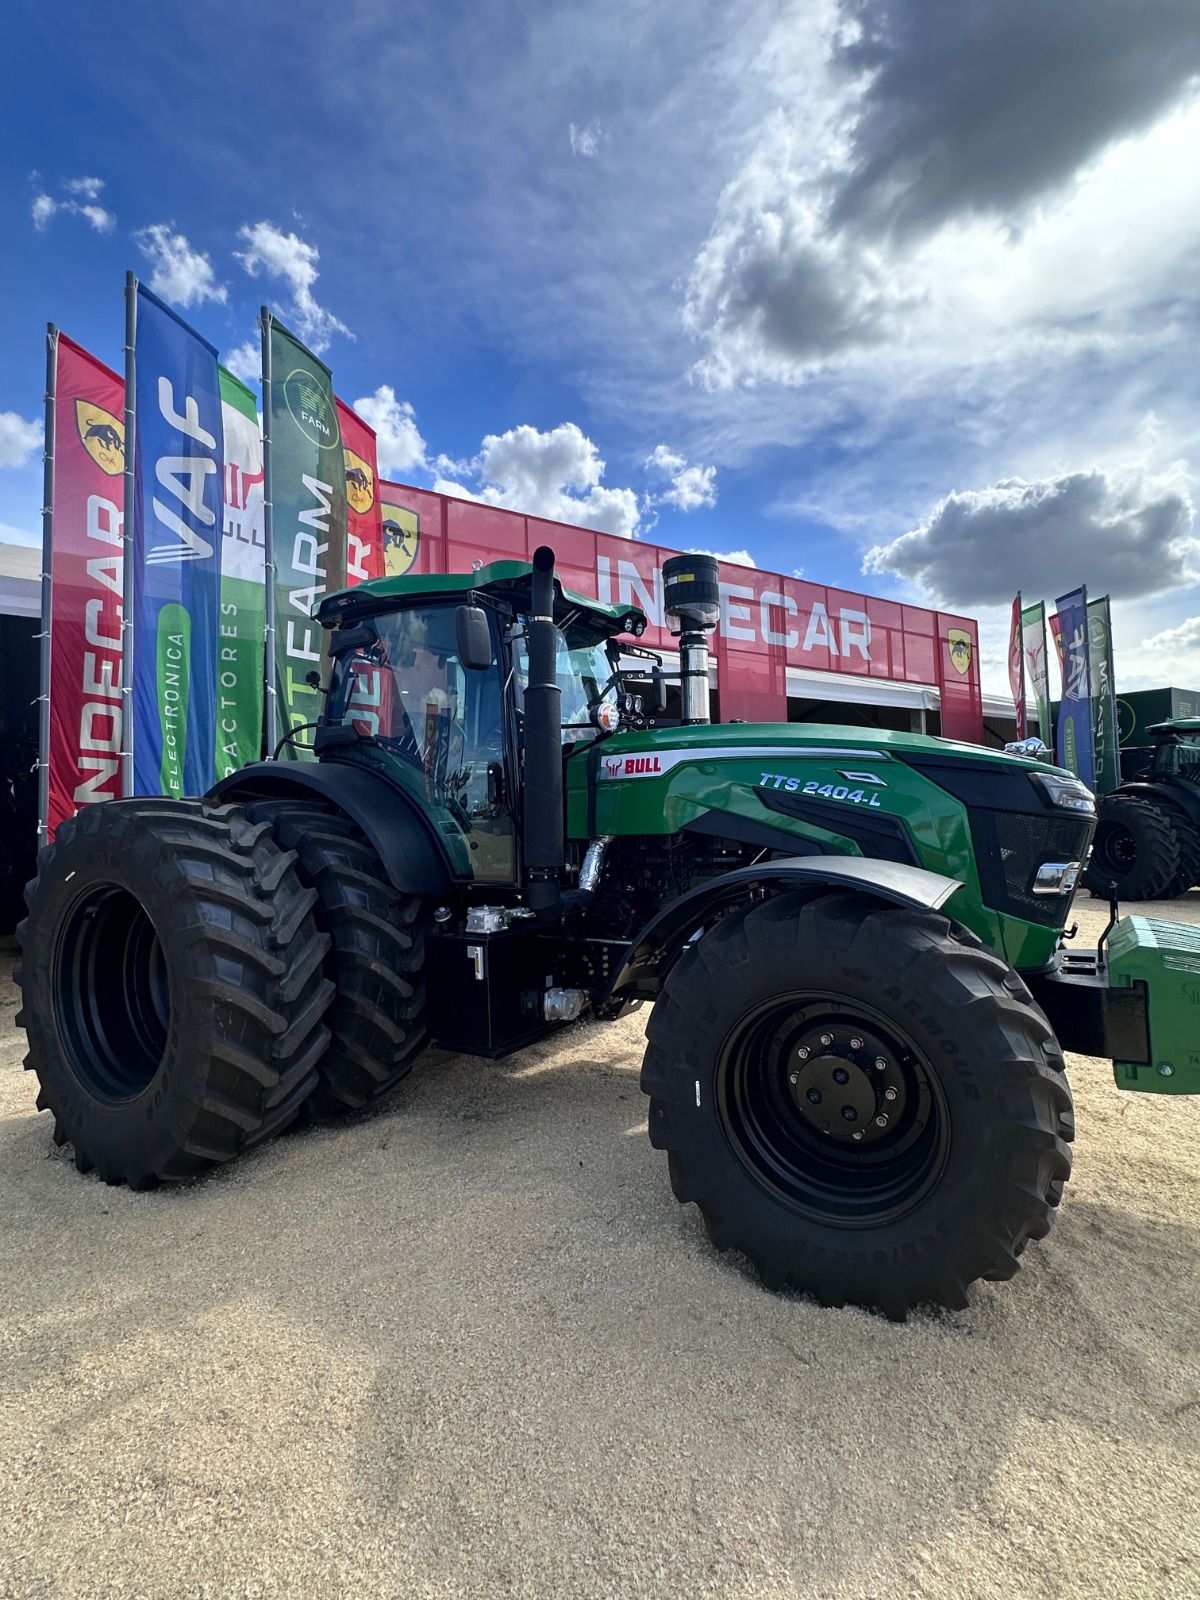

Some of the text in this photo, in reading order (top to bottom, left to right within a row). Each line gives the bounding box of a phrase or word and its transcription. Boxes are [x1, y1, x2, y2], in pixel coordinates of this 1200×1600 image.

[145, 377, 217, 564] VAF
[302, 411, 330, 436] FARM
[73, 494, 125, 817] NDECAR
[286, 473, 333, 752] PTFARM
[597, 555, 872, 661] INECAR
[165, 634, 183, 790] ELECTRONICA
[221, 603, 238, 778] RACTORES
[624, 757, 661, 774] BULL
[759, 772, 881, 807] TTS 2404-L
